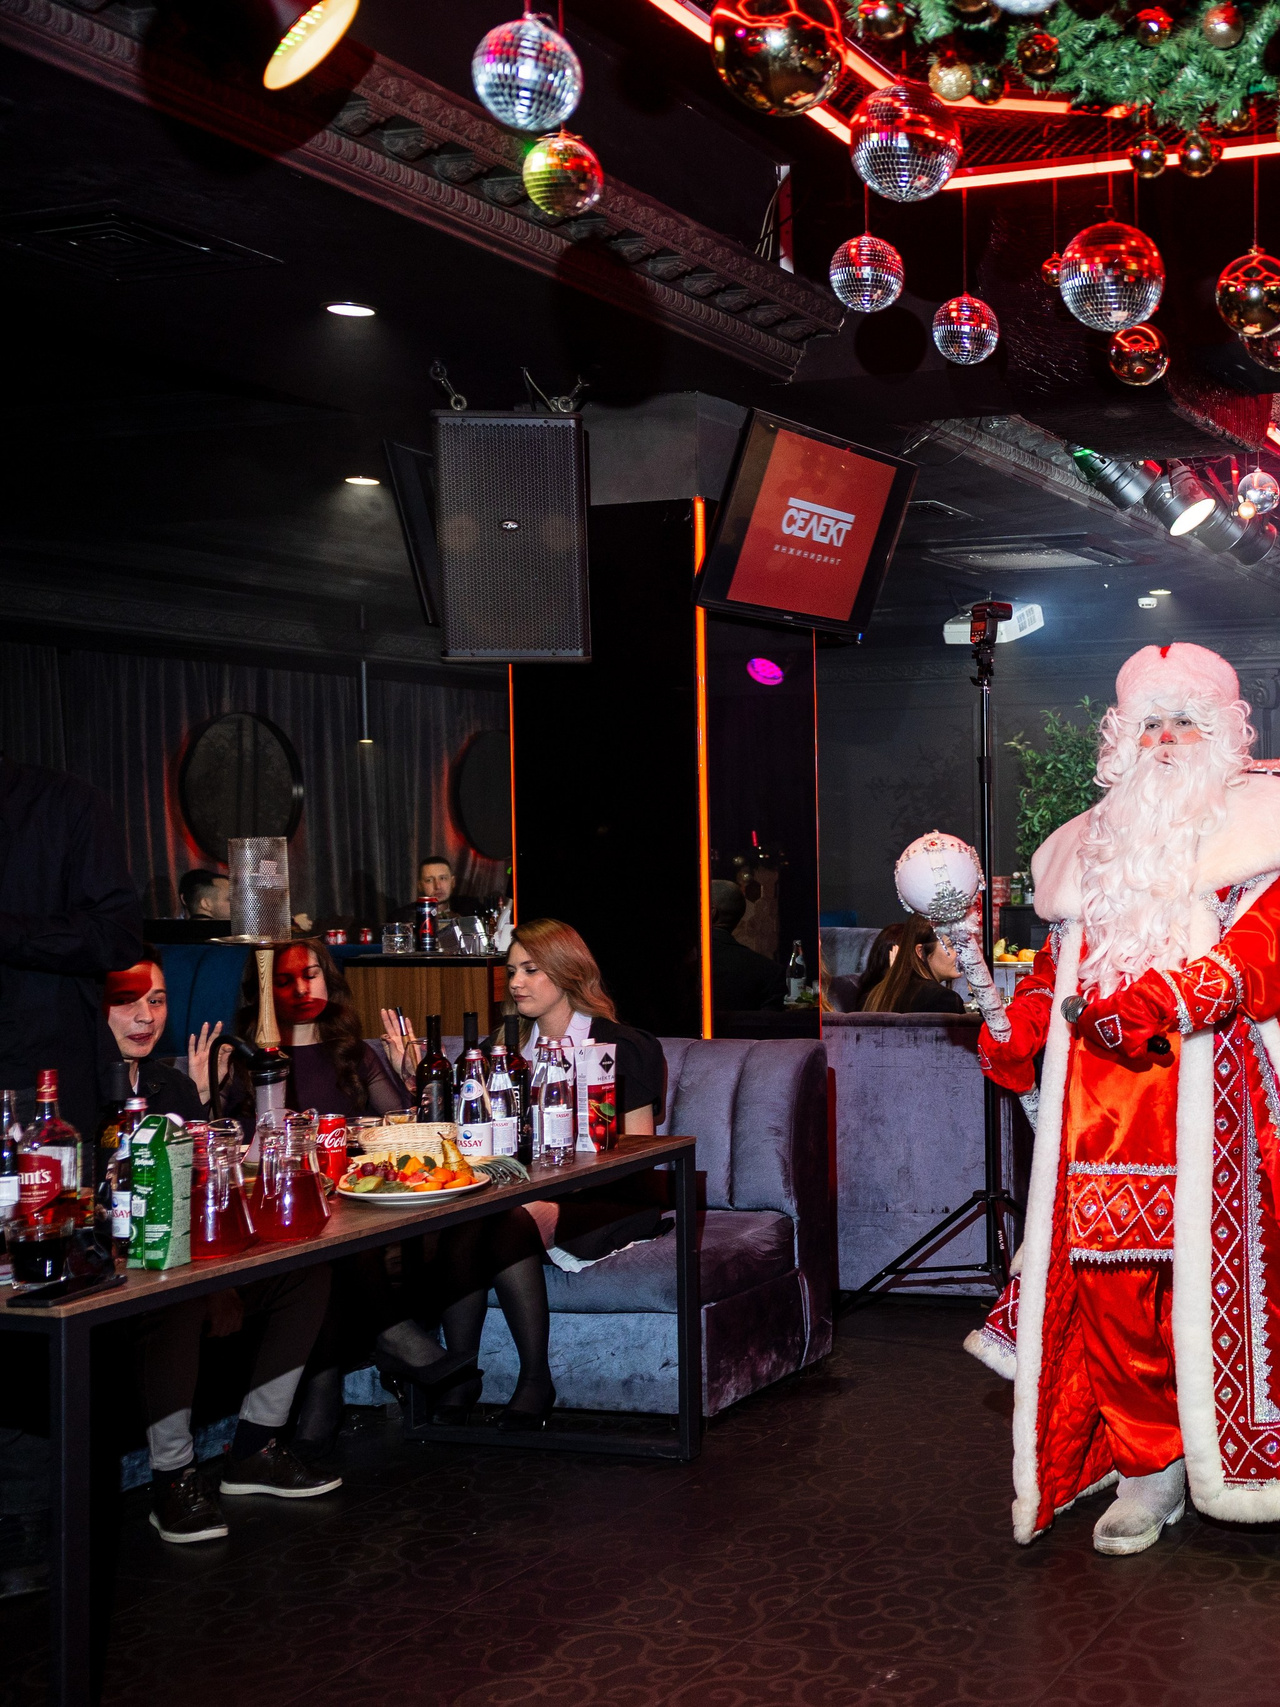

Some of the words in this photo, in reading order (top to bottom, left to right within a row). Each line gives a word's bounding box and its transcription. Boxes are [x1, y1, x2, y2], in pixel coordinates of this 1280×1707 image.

[781, 507, 853, 548] СЕЛЕКТ
[773, 544, 842, 566] инжиниринг
[17, 1168, 52, 1185] ant's
